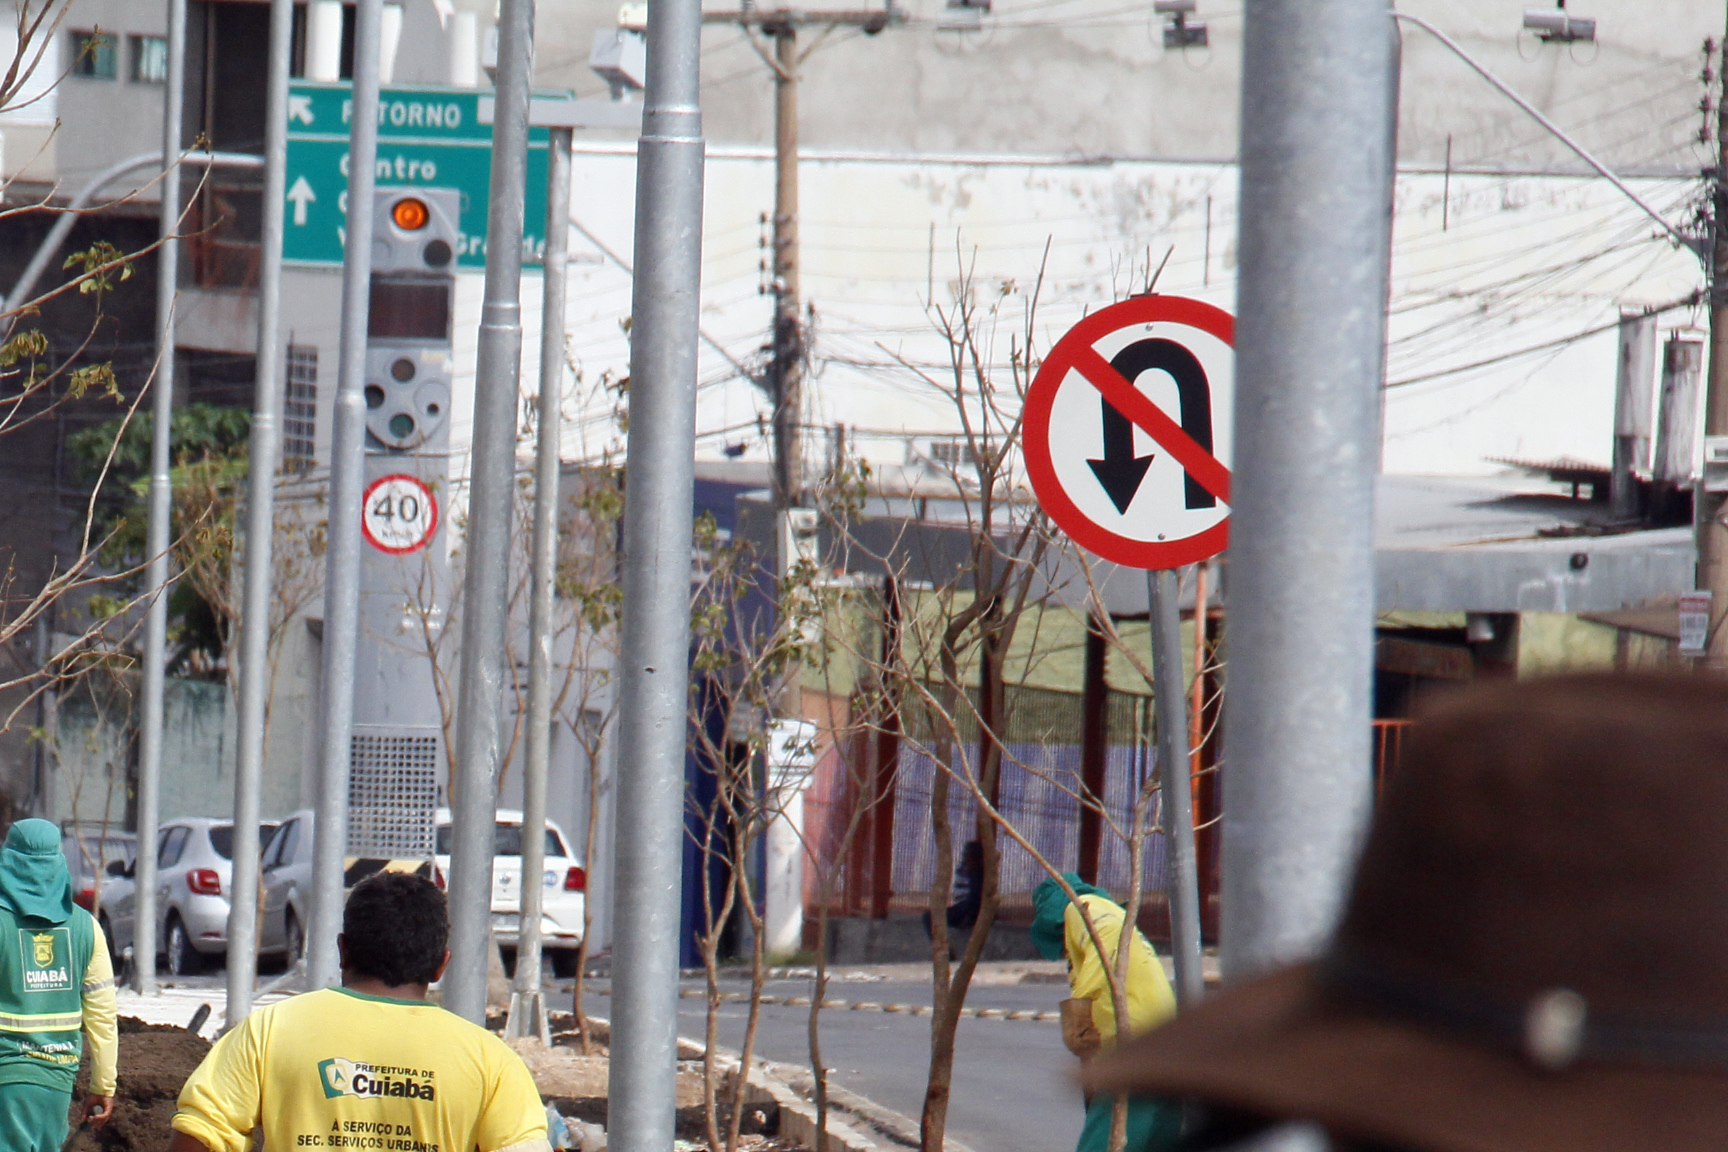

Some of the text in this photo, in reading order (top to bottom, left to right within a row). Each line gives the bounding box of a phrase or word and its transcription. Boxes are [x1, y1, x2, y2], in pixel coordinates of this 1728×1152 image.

[341, 99, 462, 129] RTORNO
[339, 152, 437, 180] Cntro
[374, 494, 418, 522] 40
[26, 966, 68, 983] CUIABÁ
[355, 1063, 435, 1079] PREFEITURA DE
[352, 1074, 435, 1101] Cuiabá
[343, 1121, 393, 1136] SERVIÇO
[396, 1125, 412, 1136] DA
[297, 1134, 324, 1147] SEC.
[328, 1135, 384, 1150] SERVIÇOS
